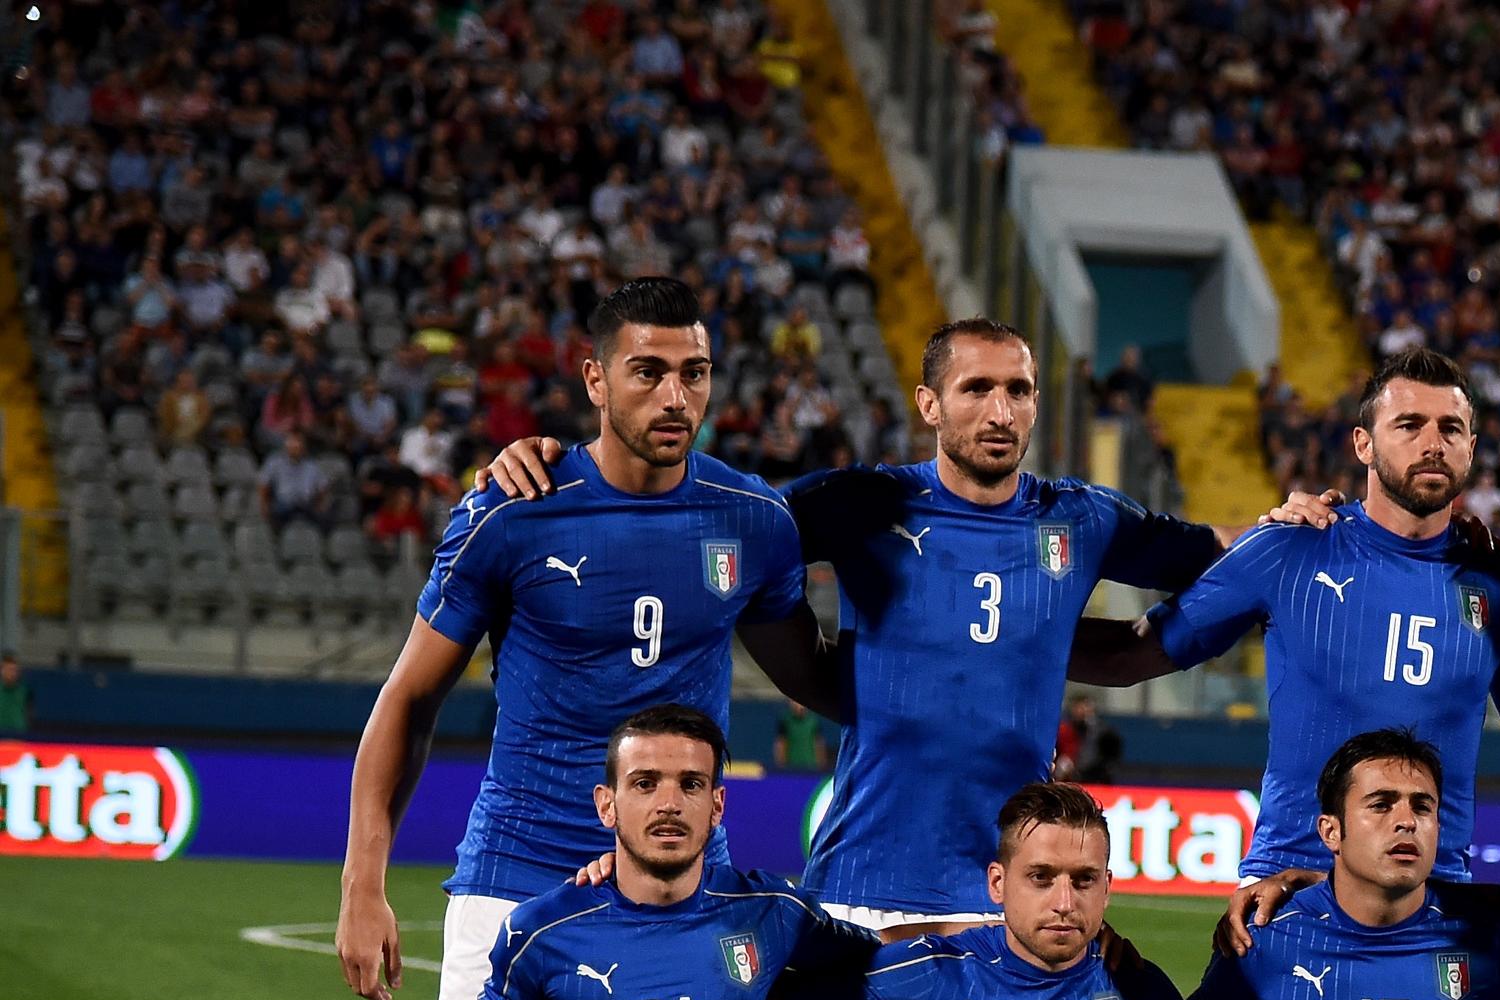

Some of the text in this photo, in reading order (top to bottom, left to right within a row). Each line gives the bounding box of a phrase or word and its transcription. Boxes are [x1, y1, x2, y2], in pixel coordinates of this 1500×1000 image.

[632, 596, 663, 667] 9
[970, 573, 1001, 643] 3
[1384, 613, 1436, 685] 15
[724, 937, 749, 947] ITALIA
